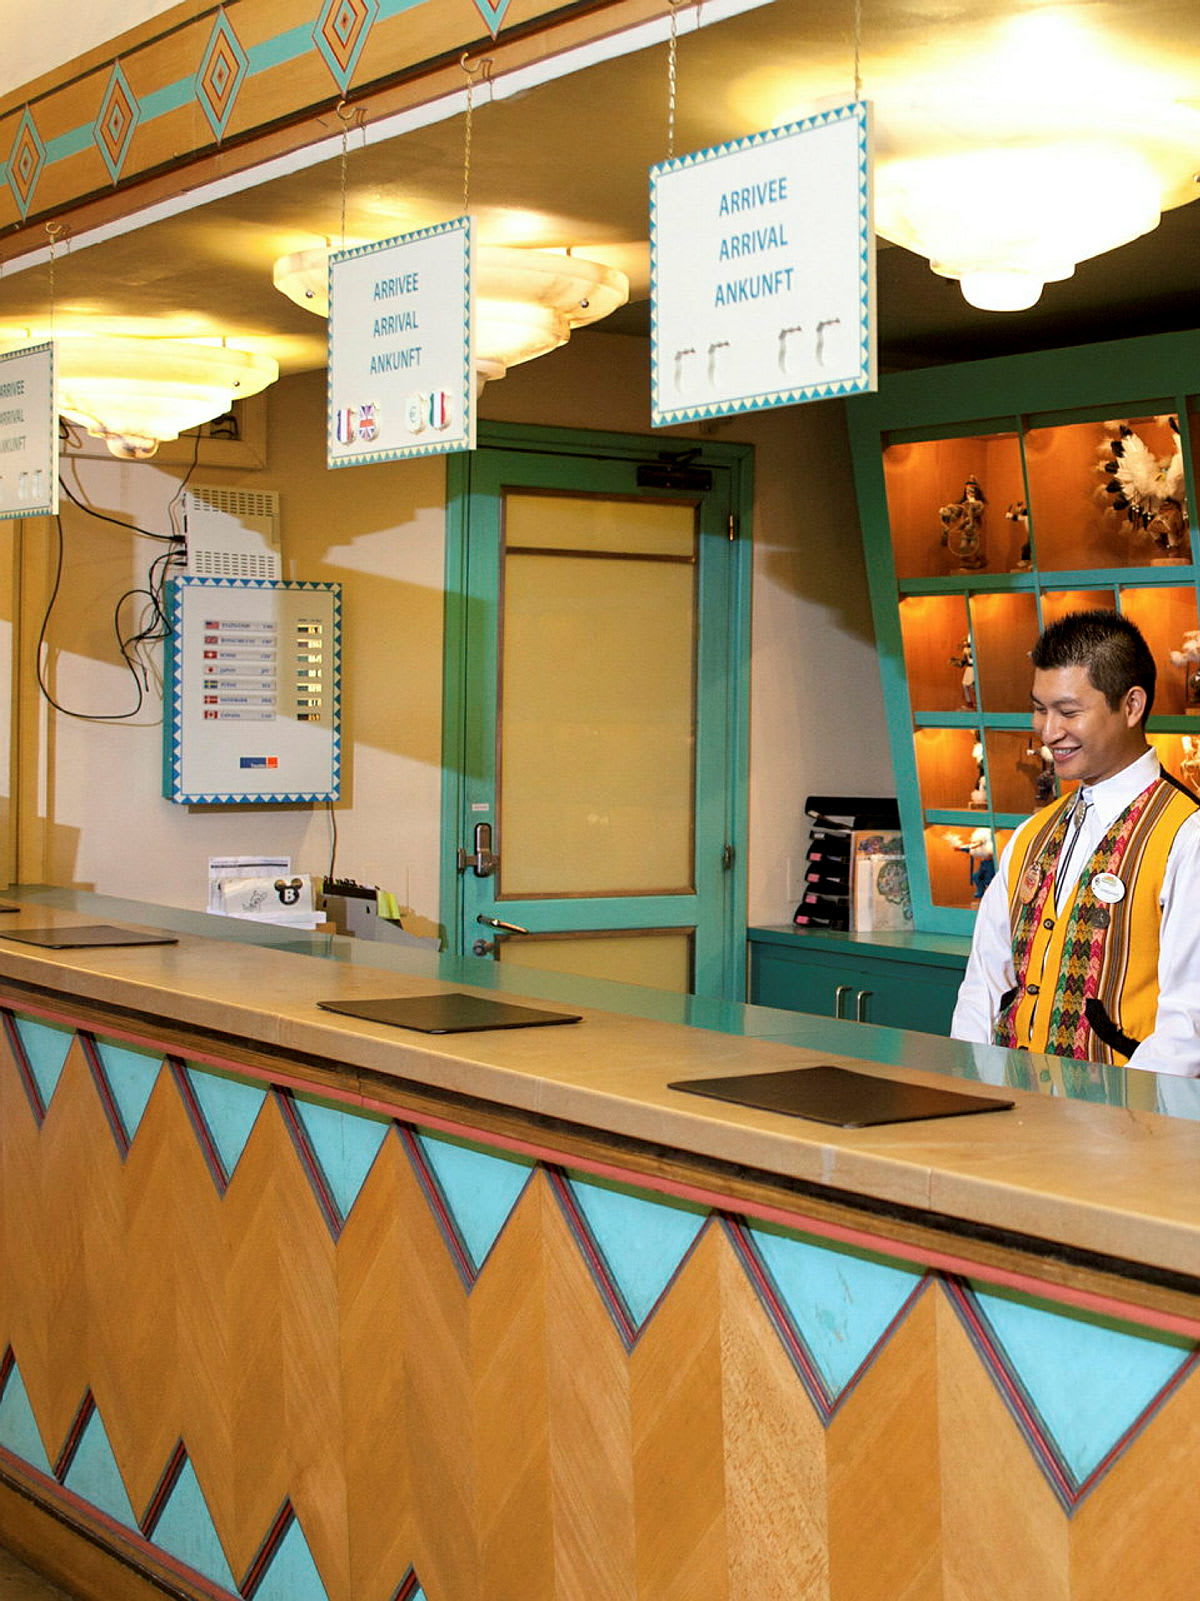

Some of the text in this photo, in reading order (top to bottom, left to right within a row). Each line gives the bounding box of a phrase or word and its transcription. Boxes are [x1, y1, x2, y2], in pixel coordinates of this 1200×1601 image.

[719, 177, 788, 217] ARRIVEE
[719, 224, 788, 262] ARRIVAL
[373, 273, 419, 301] ARRIVEE
[714, 268, 794, 308] ANKUNFT
[373, 311, 419, 338] ARRIVAL
[370, 347, 422, 375] ANKUNFT
[284, 888, 296, 902] B
